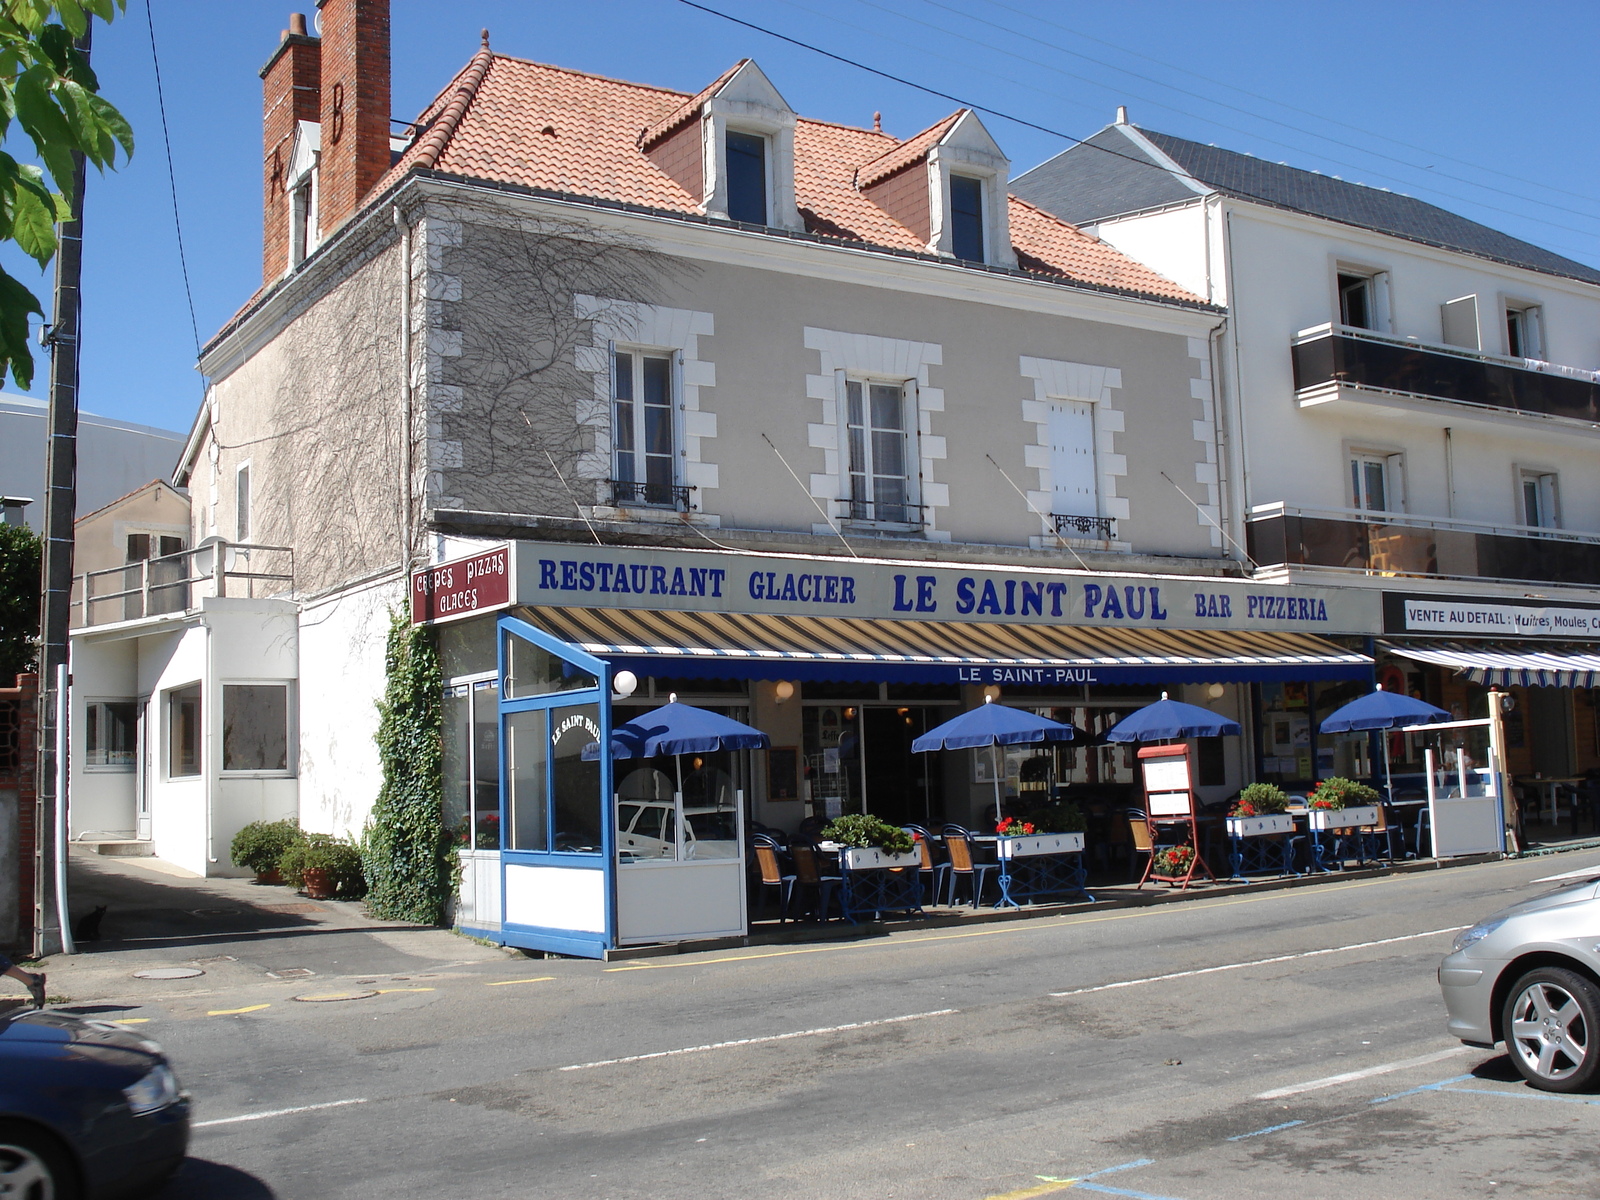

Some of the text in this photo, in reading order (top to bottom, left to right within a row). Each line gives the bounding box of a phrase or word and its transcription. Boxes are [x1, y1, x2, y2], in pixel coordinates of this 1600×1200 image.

[467, 553, 504, 584] PIZZAS
[440, 589, 478, 612] GLACES
[538, 559, 1328, 622] RESTAURANT GLACIER LE SAINT PAUL BAR PIZZERIA
[1409, 609, 1445, 623] VENTE
[1450, 610, 1465, 623] AU
[958, 667, 1098, 683] LE SAINT-PAUL
[551, 714, 601, 746] LE SAINT PAUL
